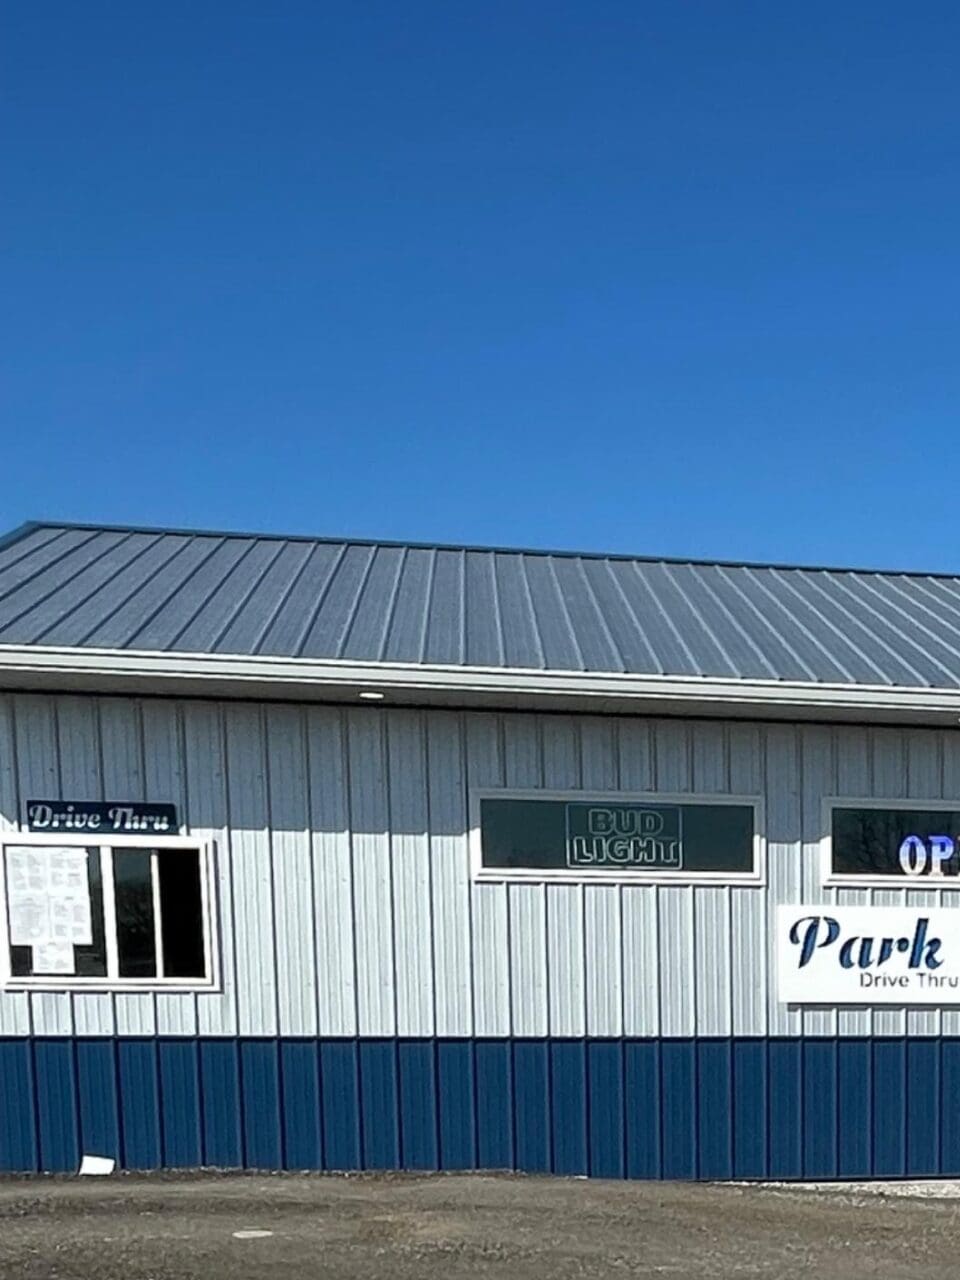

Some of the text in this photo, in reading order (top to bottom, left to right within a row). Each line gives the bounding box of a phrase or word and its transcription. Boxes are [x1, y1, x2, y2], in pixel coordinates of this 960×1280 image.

[29, 804, 170, 831] Drive Thru
[589, 809, 664, 836] BUD
[573, 836, 678, 862] LIGHT
[788, 916, 944, 969] Park
[860, 972, 909, 988] Drive
[916, 972, 959, 988] Thru
